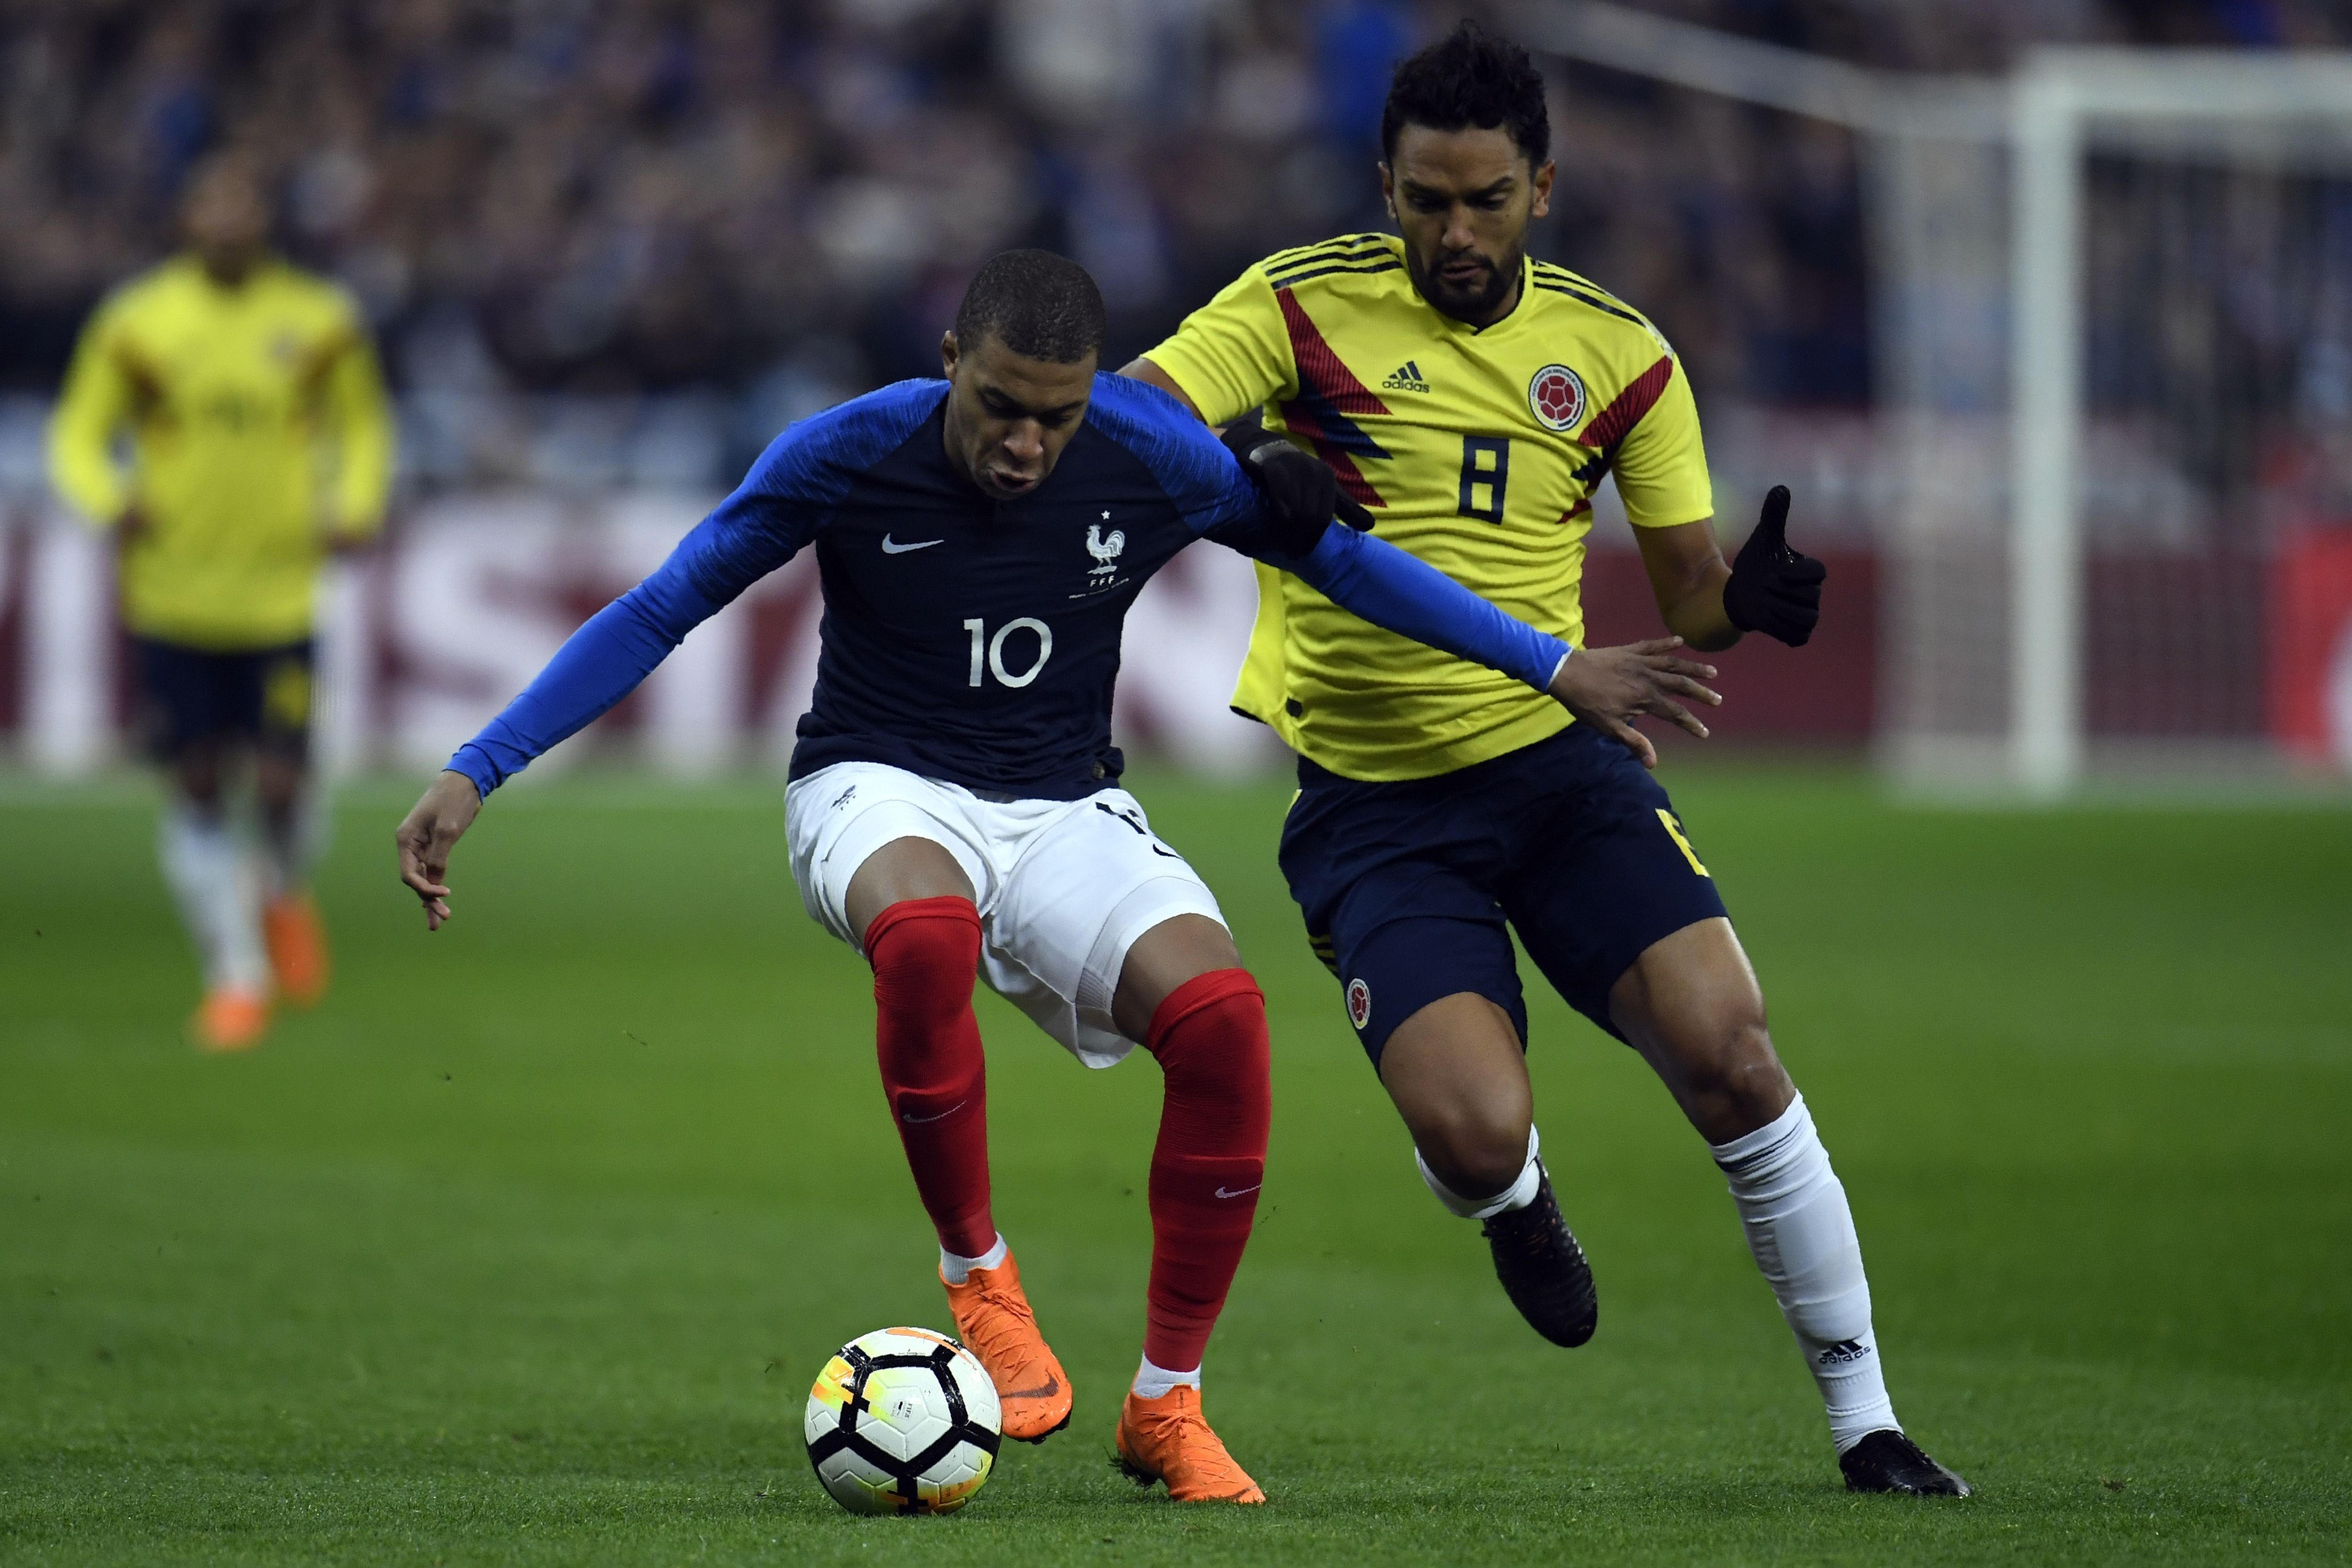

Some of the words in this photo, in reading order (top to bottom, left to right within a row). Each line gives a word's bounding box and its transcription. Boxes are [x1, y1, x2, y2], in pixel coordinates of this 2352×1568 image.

[1382, 379, 1429, 393] adidas
[1458, 435, 1509, 525] 8
[963, 617, 1052, 688] 10
[1819, 1346, 1871, 1364] adidas
